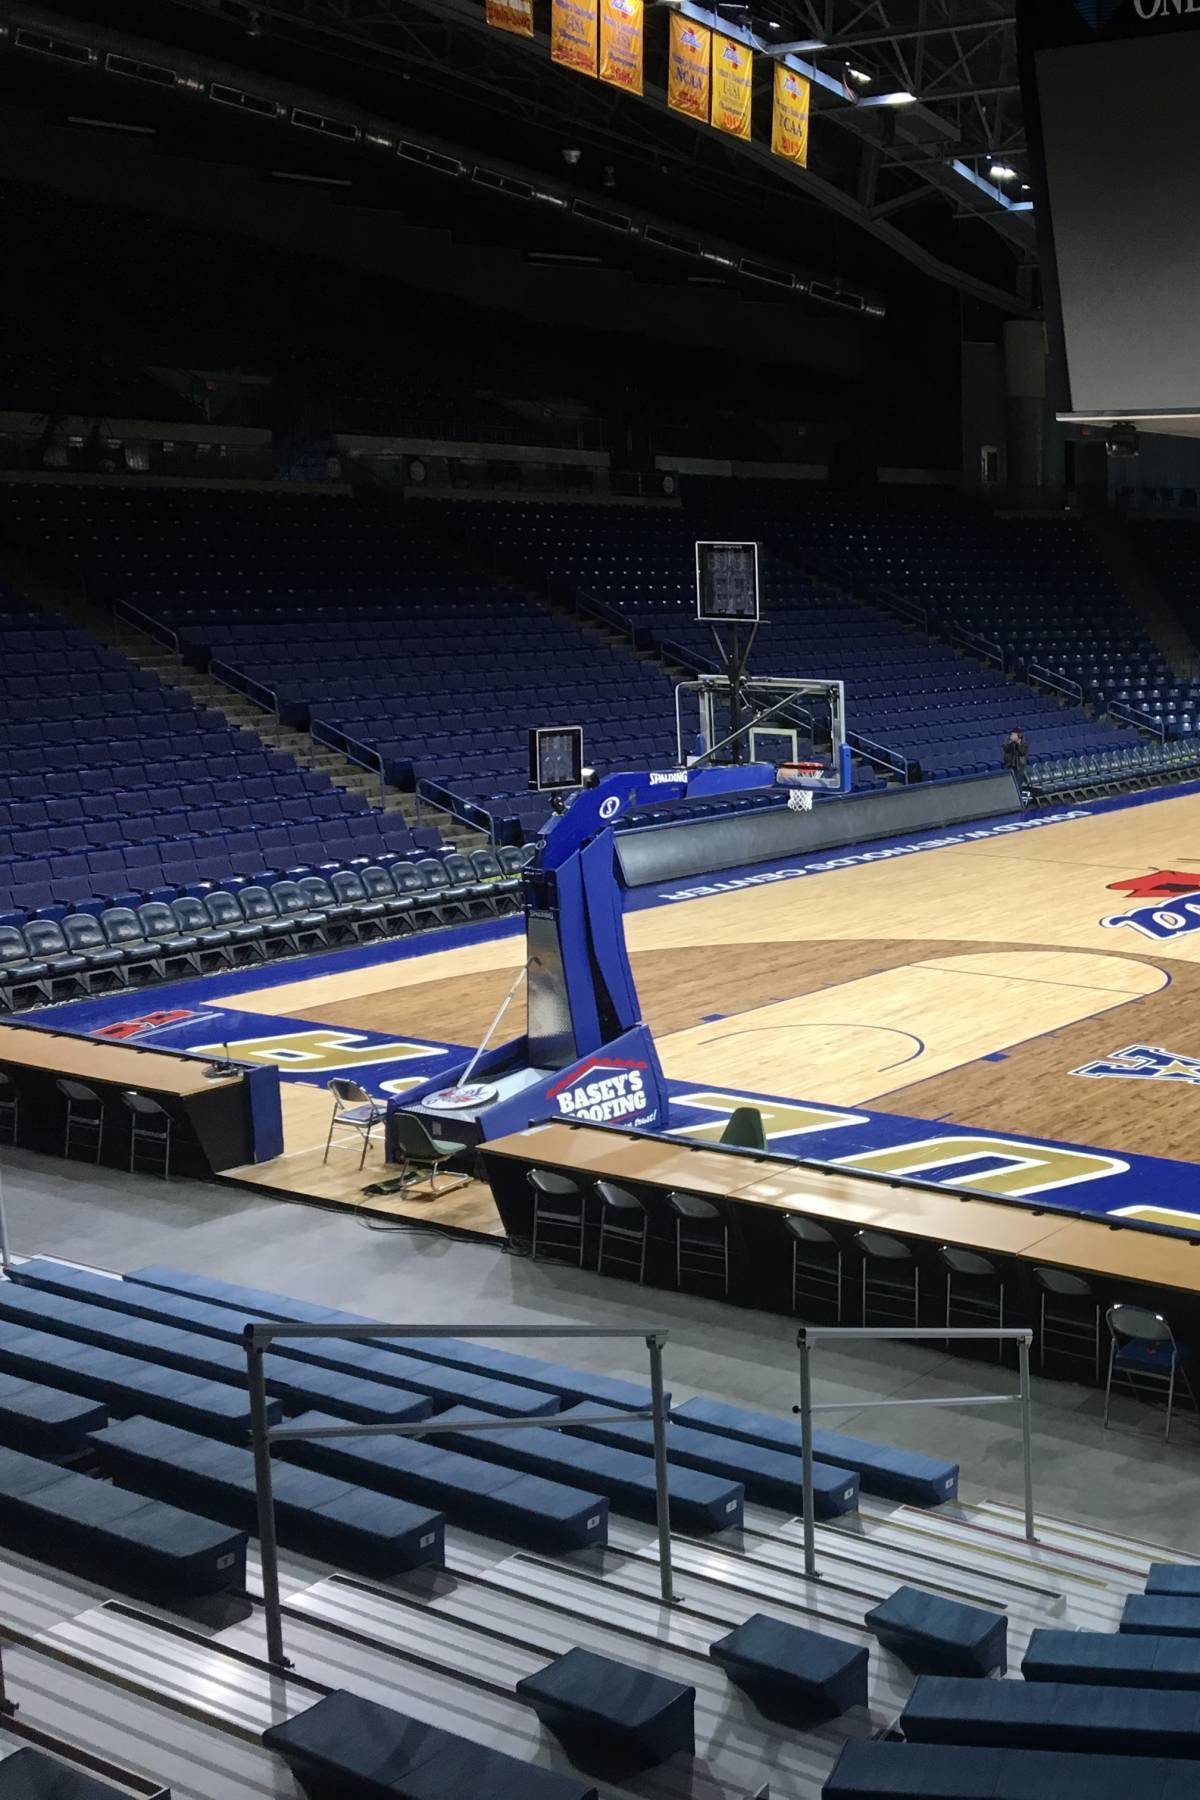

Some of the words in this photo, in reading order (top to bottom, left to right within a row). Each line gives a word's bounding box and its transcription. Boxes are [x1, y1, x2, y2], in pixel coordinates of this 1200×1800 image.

[649, 770, 688, 786] SPALDING
[992, 810, 1094, 833] DONALD
[805, 836, 965, 871] REYNOLDS
[658, 868, 807, 900] CENTER
[556, 1070, 643, 1114] BASEY'S
[568, 1091, 647, 1122] OOFING
